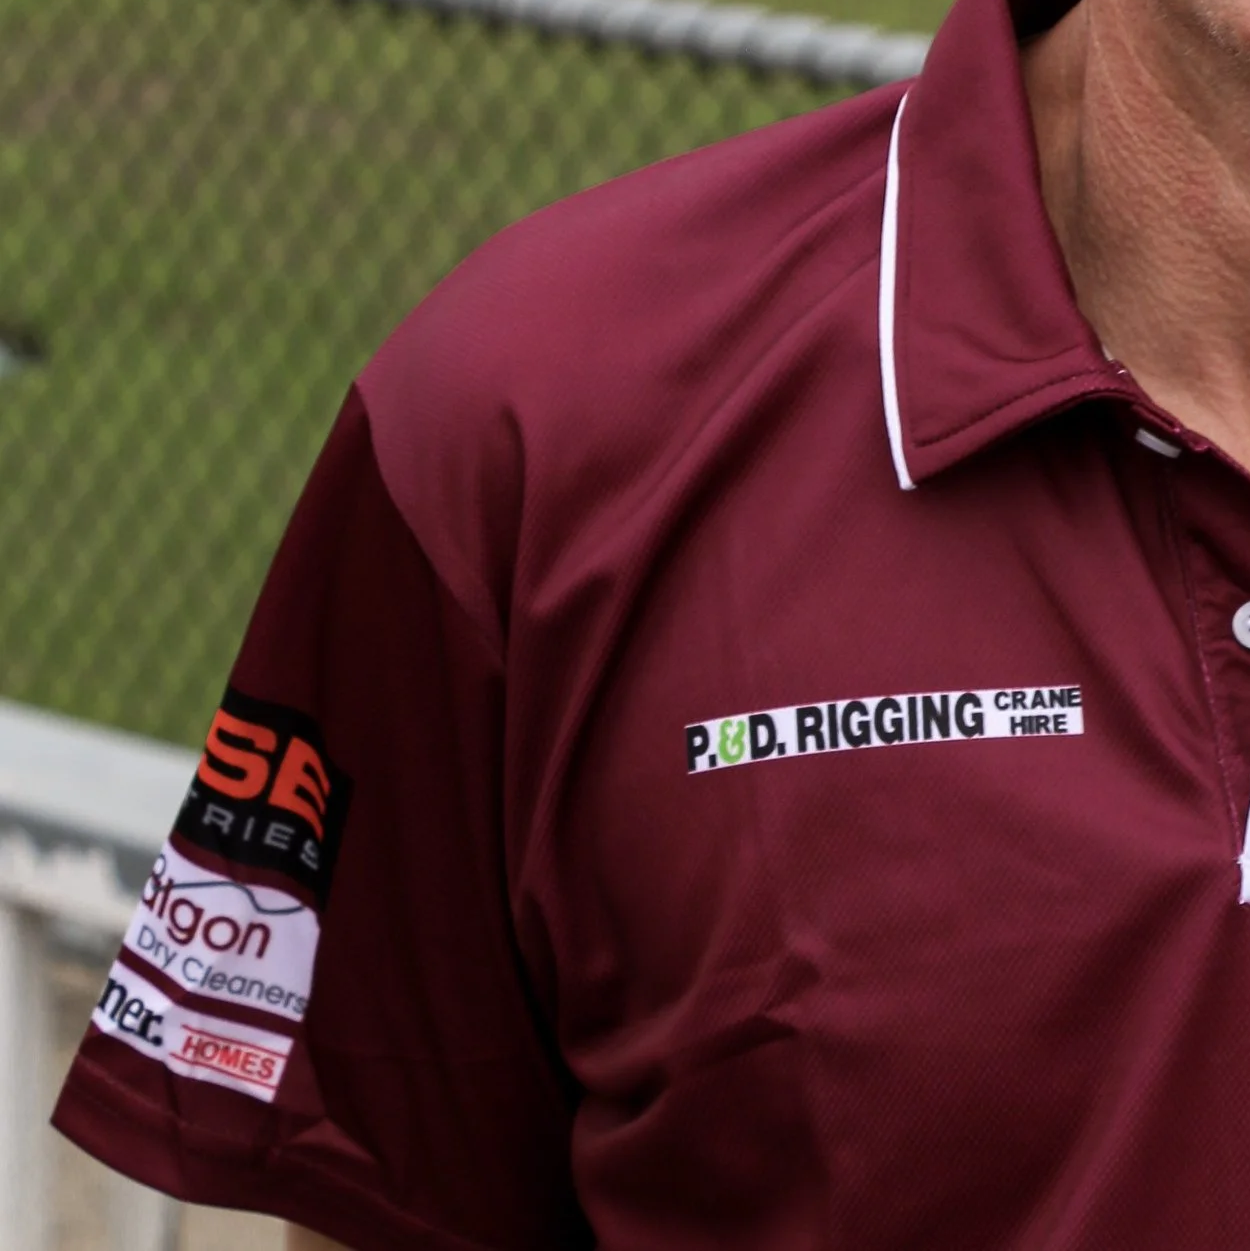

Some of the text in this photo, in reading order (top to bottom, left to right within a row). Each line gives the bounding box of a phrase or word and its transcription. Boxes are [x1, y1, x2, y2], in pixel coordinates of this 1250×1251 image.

[994, 688, 1082, 711] CRANE
[796, 692, 984, 754] RIGGING
[1010, 714, 1068, 735] HIRE
[136, 924, 307, 1014] Dry Cleaners
[182, 1035, 275, 1080] HOMES
